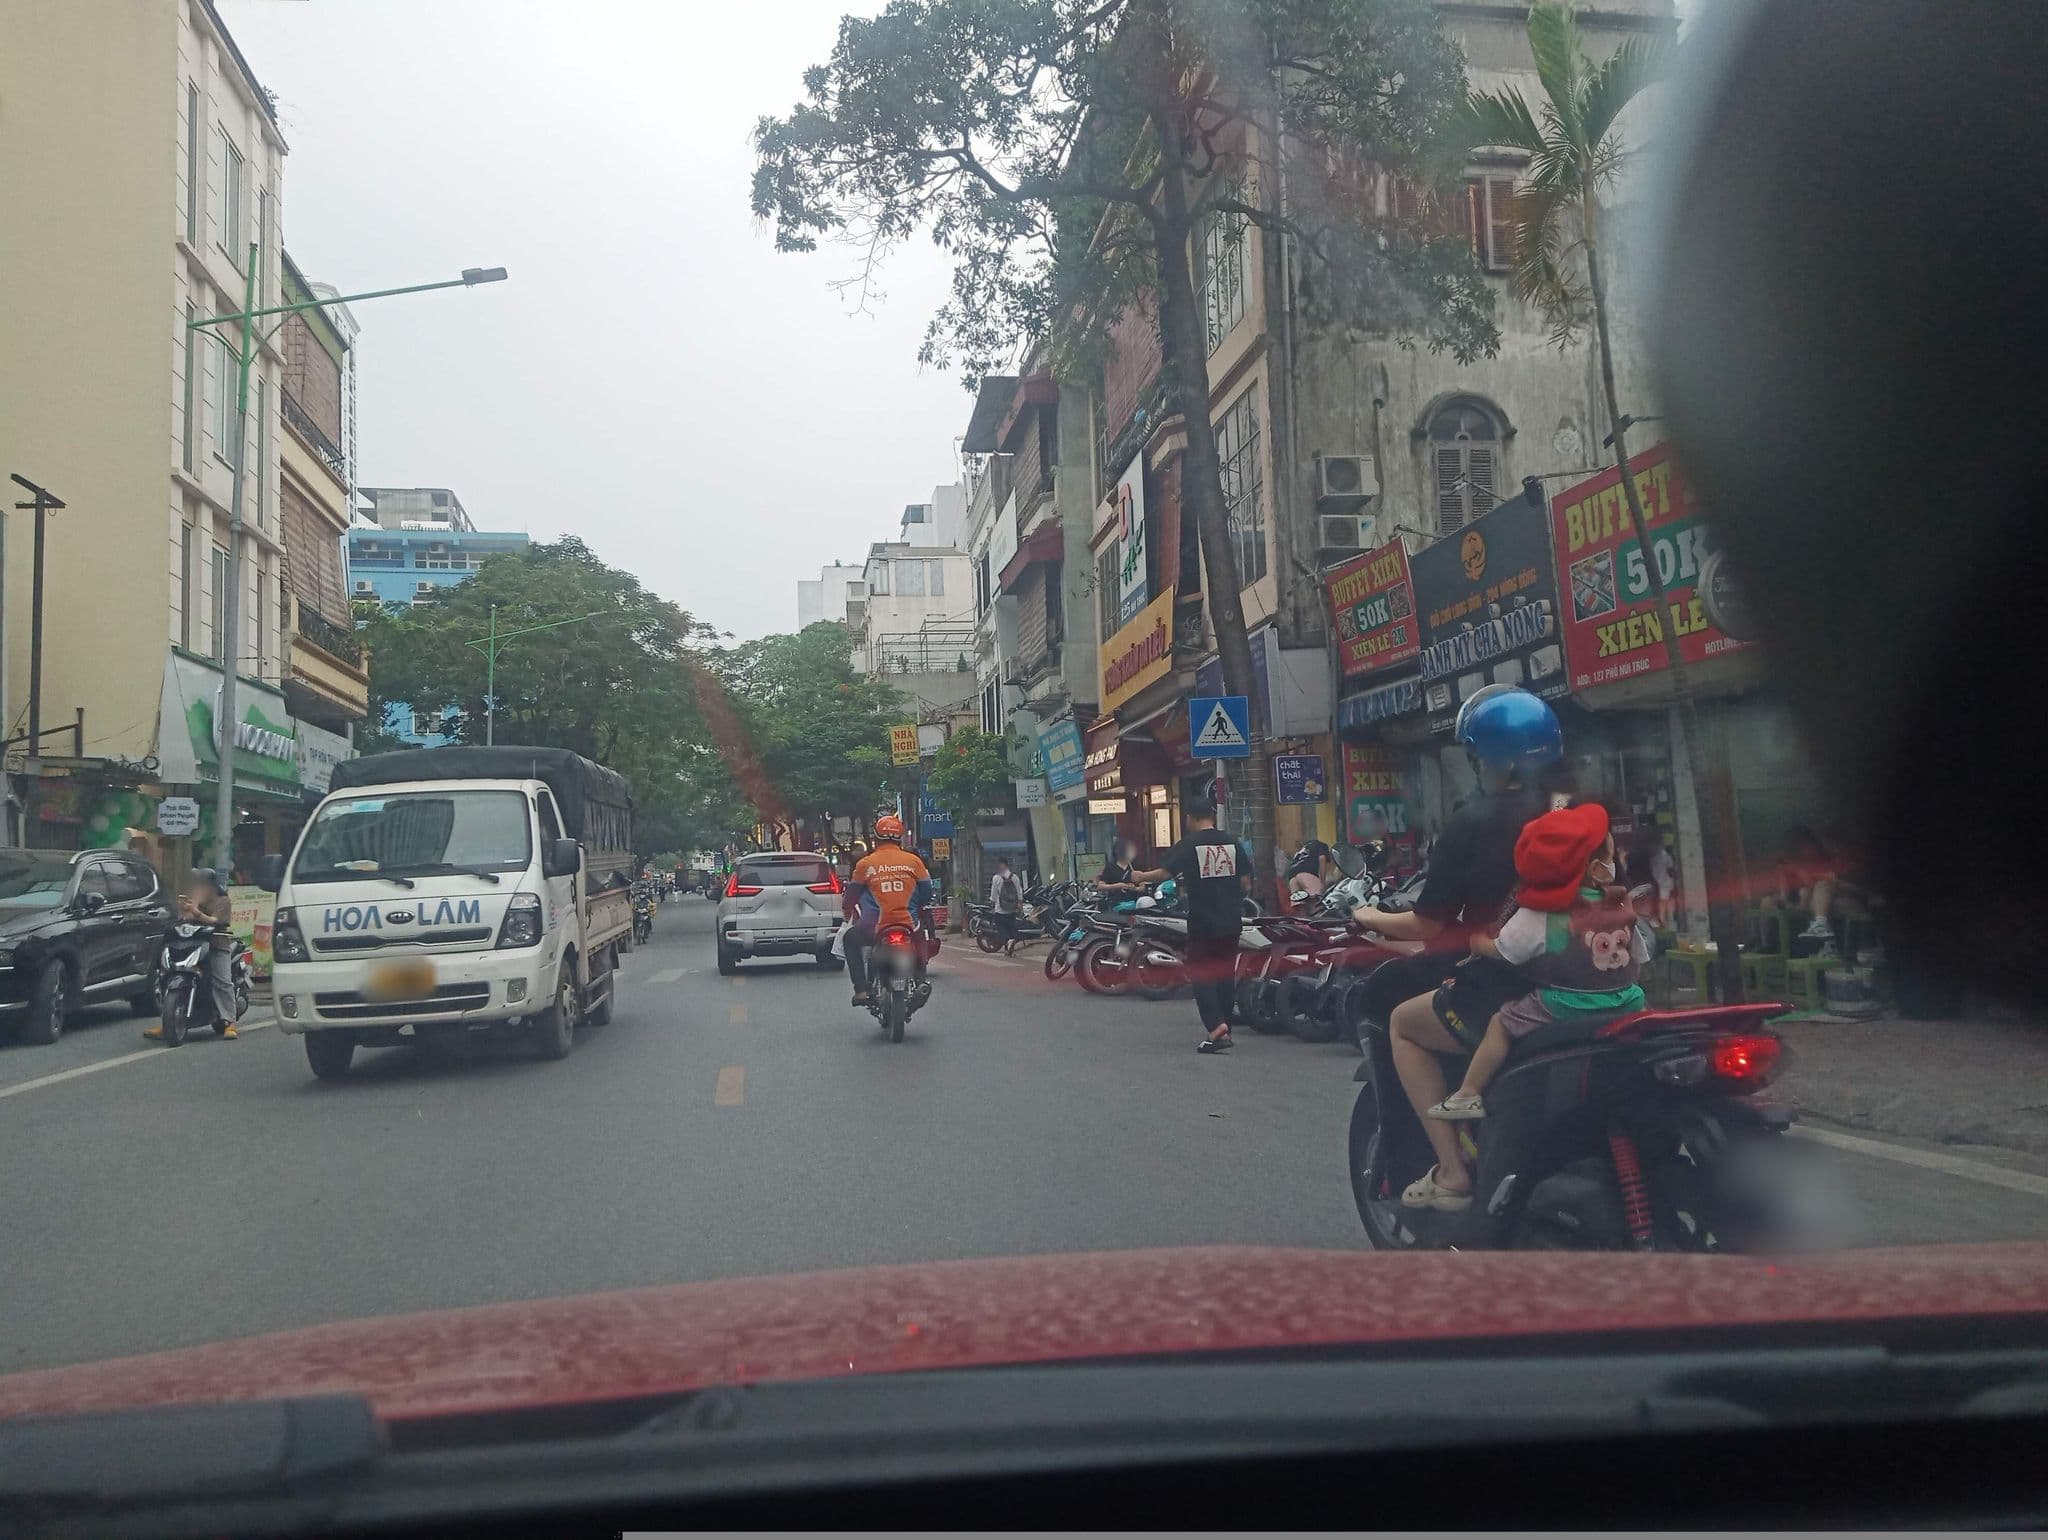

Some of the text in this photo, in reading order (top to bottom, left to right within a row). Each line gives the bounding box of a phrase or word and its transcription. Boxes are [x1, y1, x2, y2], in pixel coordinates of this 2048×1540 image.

[1331, 565, 1369, 607] BUFFET
[1357, 598, 1390, 631] 50K
[1596, 610, 1663, 658] XIÊN
[324, 906, 383, 932] HOA
[418, 897, 481, 926] LÂM
